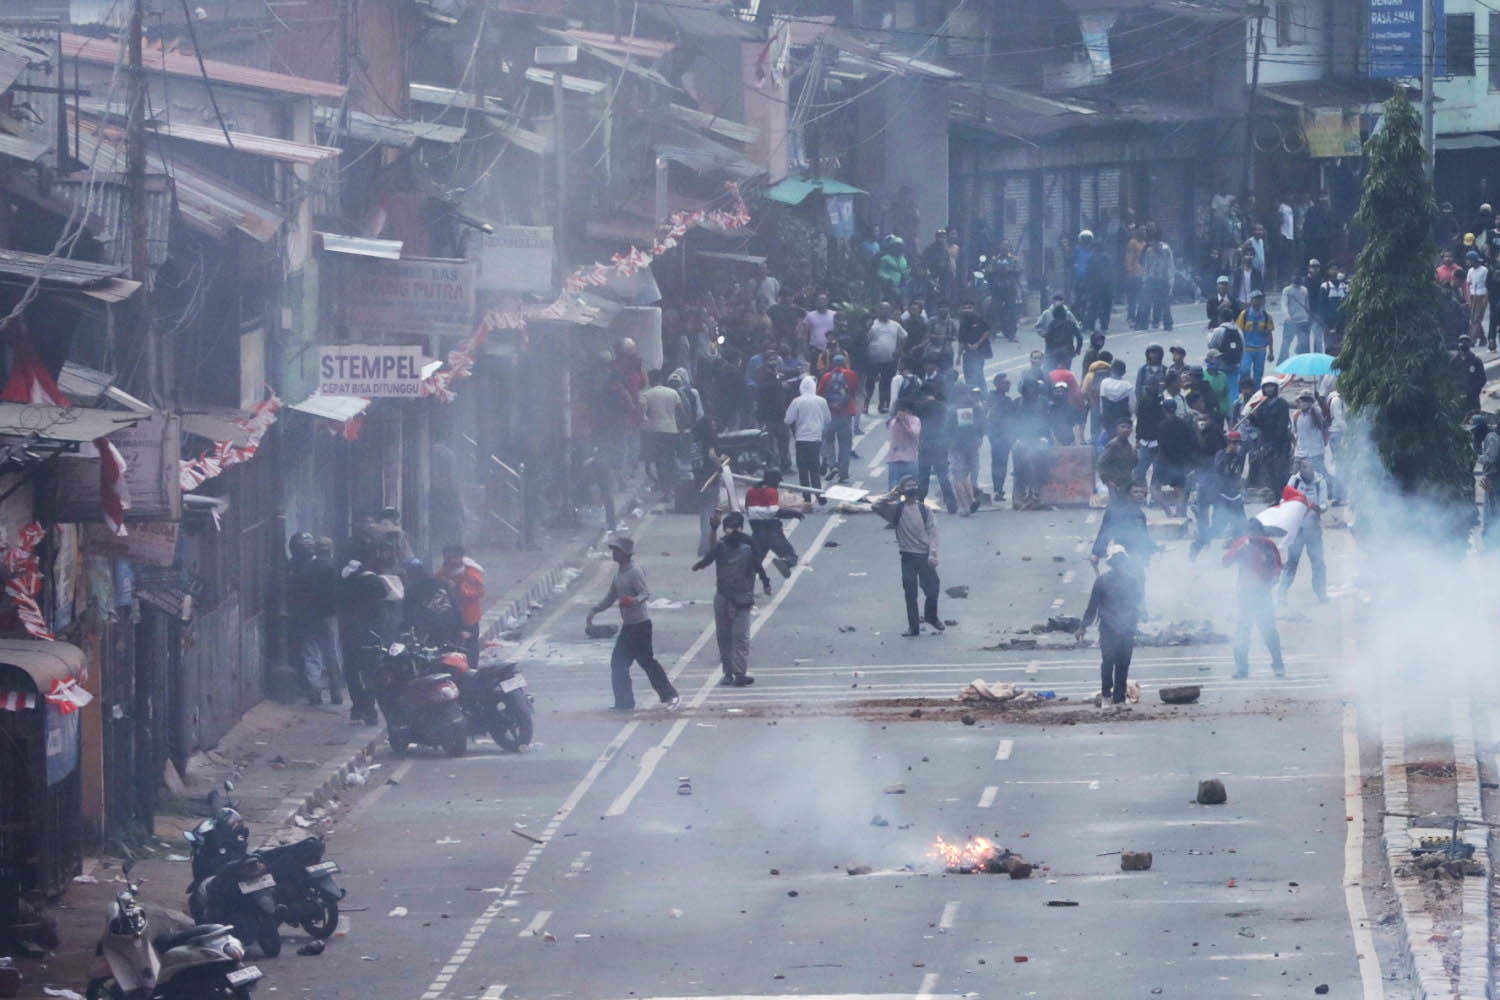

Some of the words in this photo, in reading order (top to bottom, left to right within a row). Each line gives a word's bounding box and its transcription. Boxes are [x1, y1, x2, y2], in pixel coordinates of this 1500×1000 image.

[321, 355, 420, 379] STEMPEL
[352, 383, 372, 394] BISA
[373, 383, 419, 394] DITUNGGU
